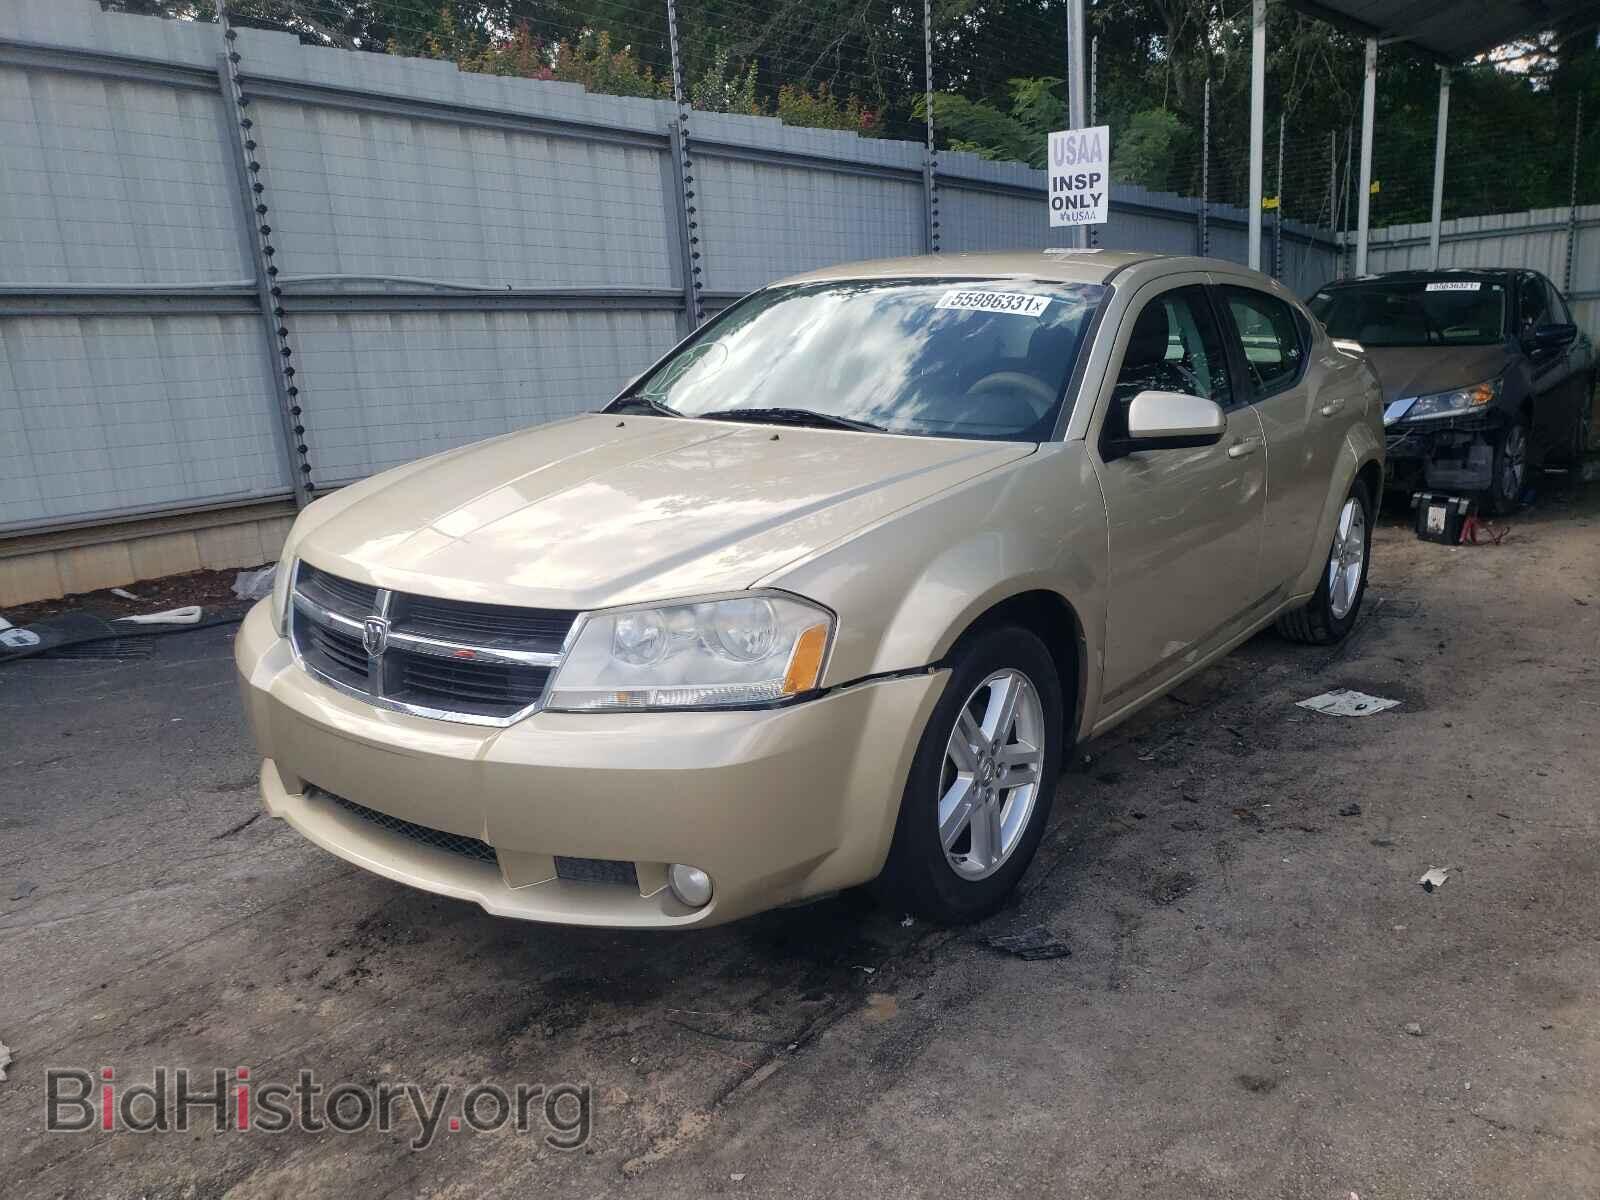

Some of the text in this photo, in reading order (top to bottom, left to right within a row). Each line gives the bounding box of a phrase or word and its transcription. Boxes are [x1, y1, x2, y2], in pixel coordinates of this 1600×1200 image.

[1053, 134, 1102, 166] USAA
[1052, 173, 1101, 192] INSP
[1051, 193, 1102, 210] ONLY
